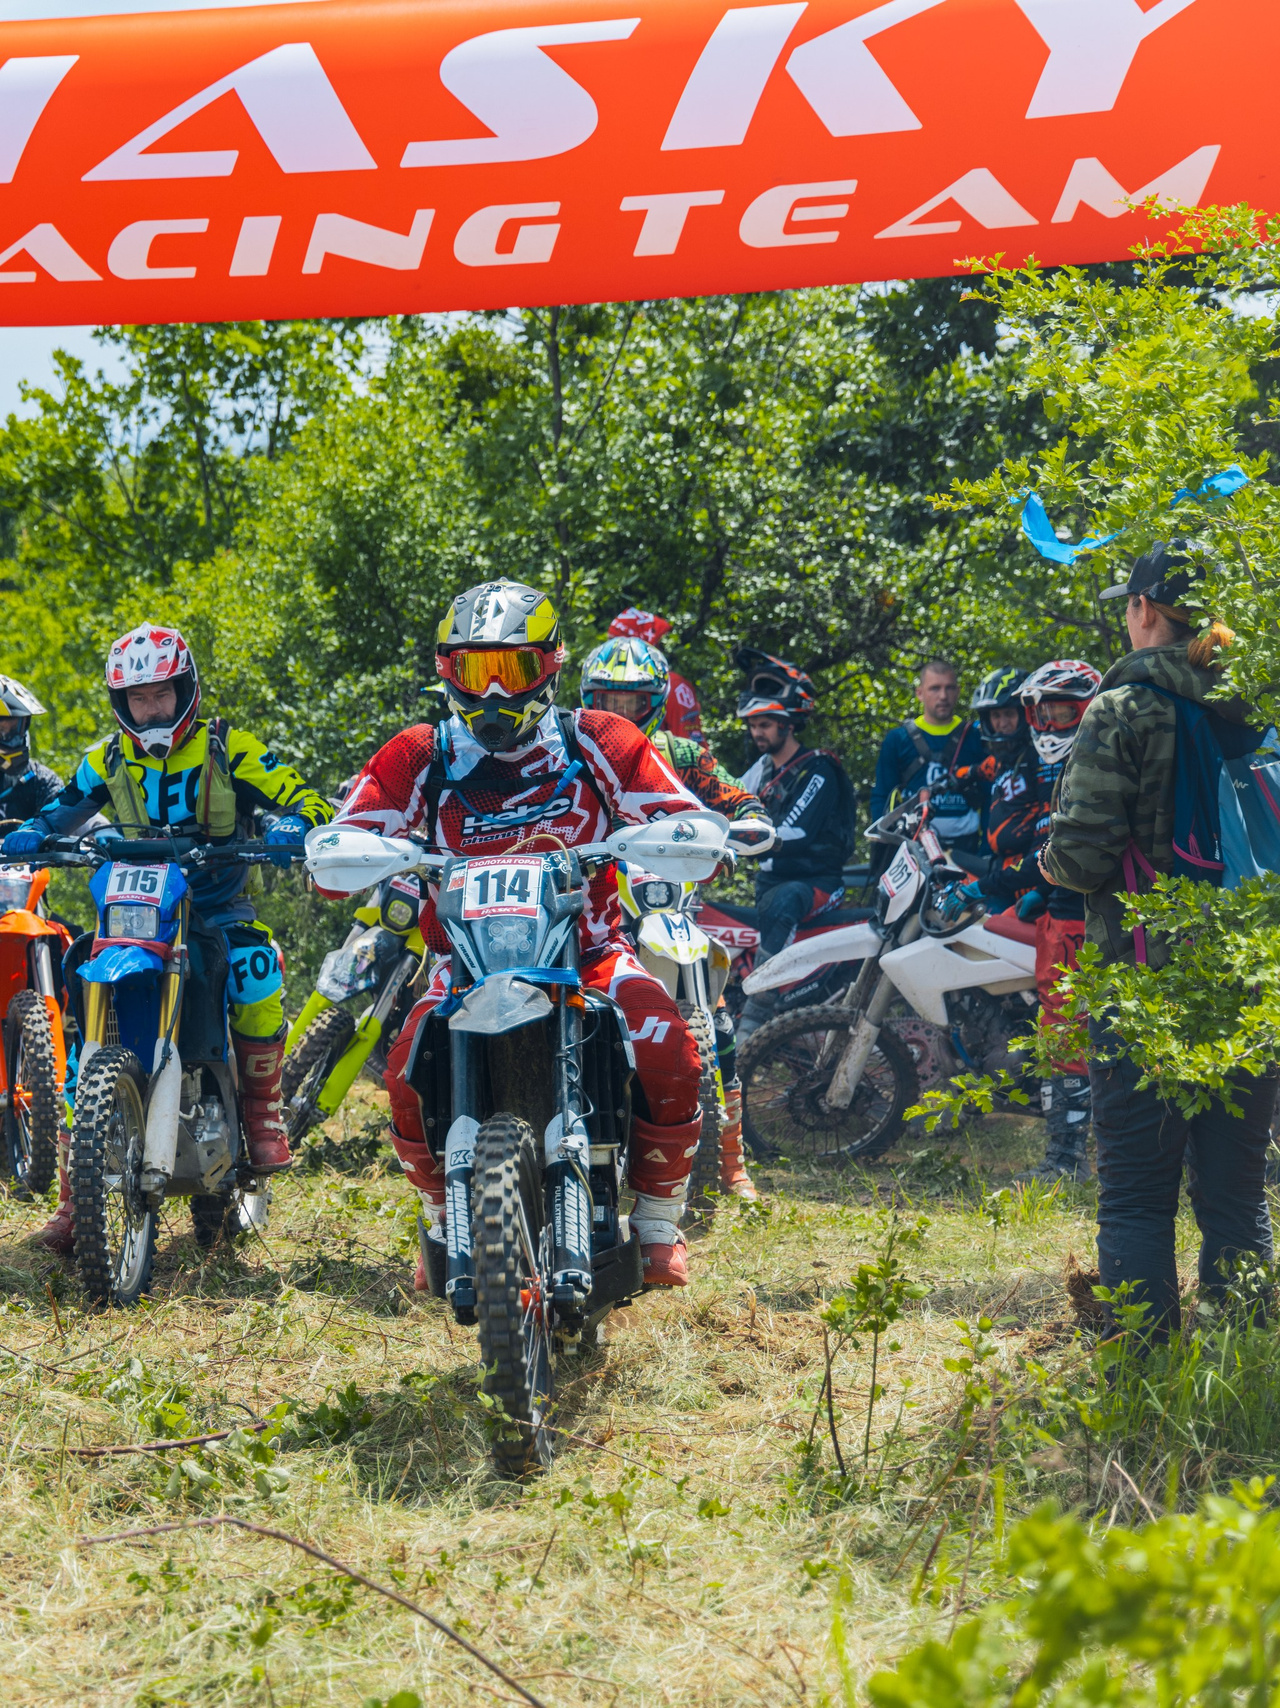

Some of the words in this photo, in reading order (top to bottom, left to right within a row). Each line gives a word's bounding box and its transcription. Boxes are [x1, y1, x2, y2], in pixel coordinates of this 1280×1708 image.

[620, 144, 1222, 257] TEAM
[271, 824, 303, 834] FOX
[115, 869, 159, 894] 115
[474, 868, 531, 906] 114
[783, 982, 819, 1002] GASGAS
[564, 1175, 579, 1257] ZUUMAV
